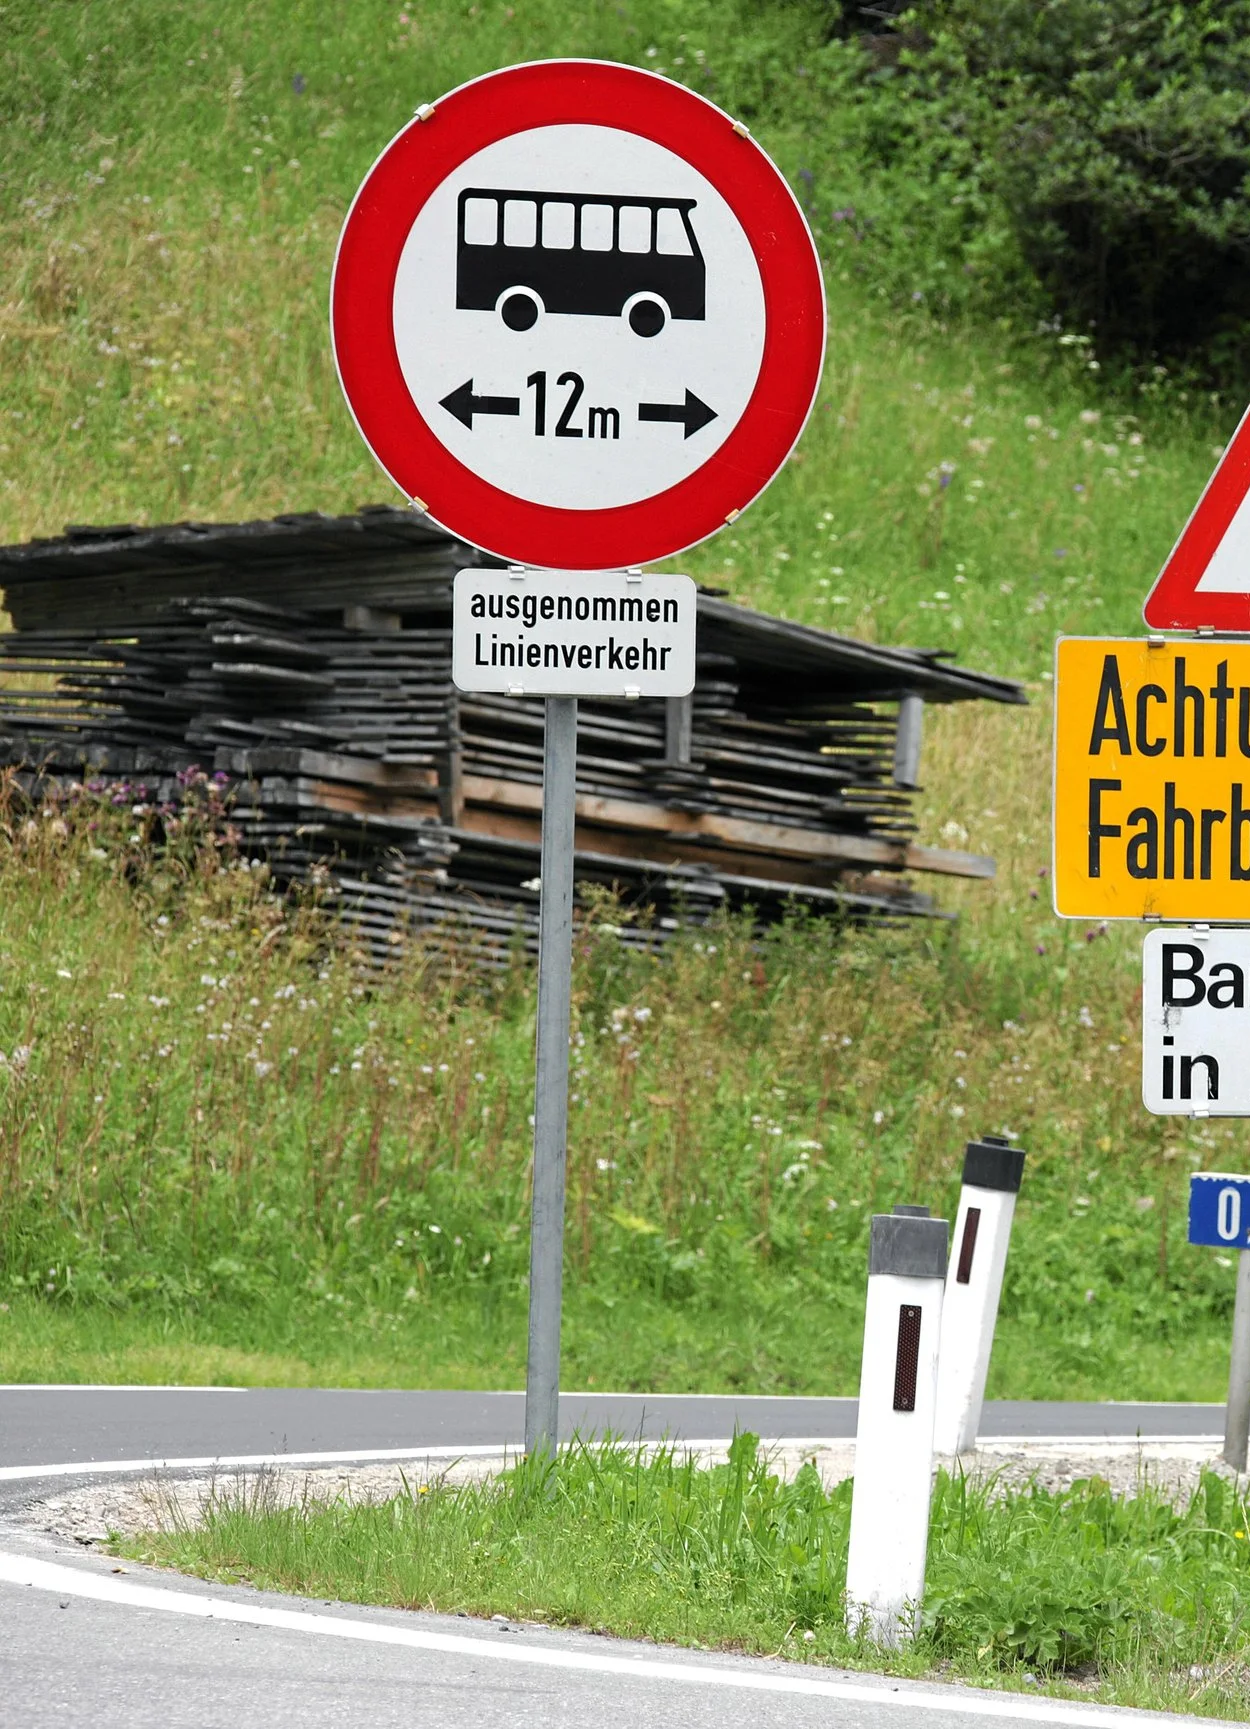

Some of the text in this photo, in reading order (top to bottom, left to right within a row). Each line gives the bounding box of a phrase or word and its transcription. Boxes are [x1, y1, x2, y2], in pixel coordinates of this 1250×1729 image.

[526, 370, 621, 440] 12m
[470, 592, 679, 628] ausgenommen
[474, 632, 672, 671] Linienverkehr
[1161, 1035, 1220, 1100] in
